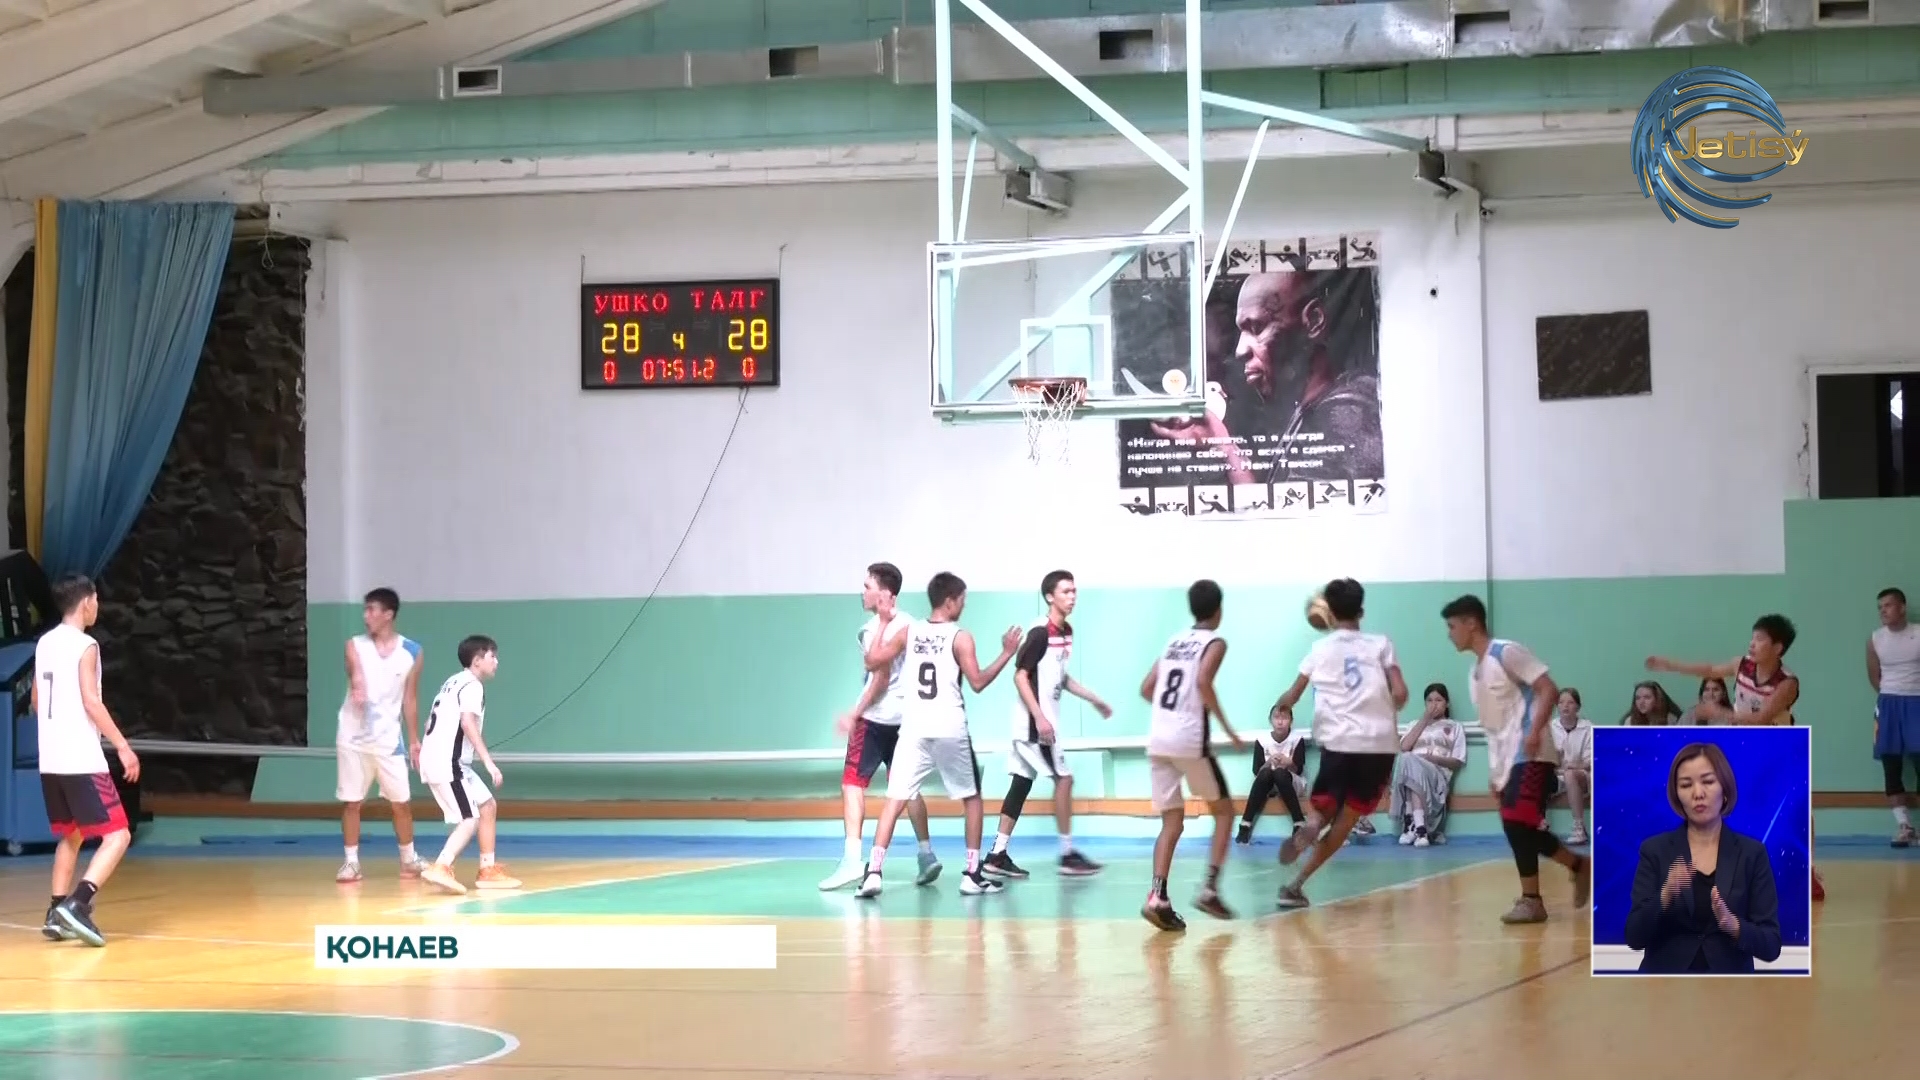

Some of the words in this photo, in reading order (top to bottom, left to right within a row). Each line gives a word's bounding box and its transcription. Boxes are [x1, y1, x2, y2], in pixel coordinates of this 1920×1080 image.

[594, 293, 669, 314] УШКО
[690, 290, 764, 311] ТАЛГ
[601, 322, 640, 354] 28
[672, 332, 686, 350] 4
[728, 319, 768, 350] 28
[603, 360, 617, 382] 0
[742, 357, 756, 379] 0
[918, 661, 938, 700] 9
[1160, 668, 1184, 711] 8
[1344, 655, 1363, 690] 5
